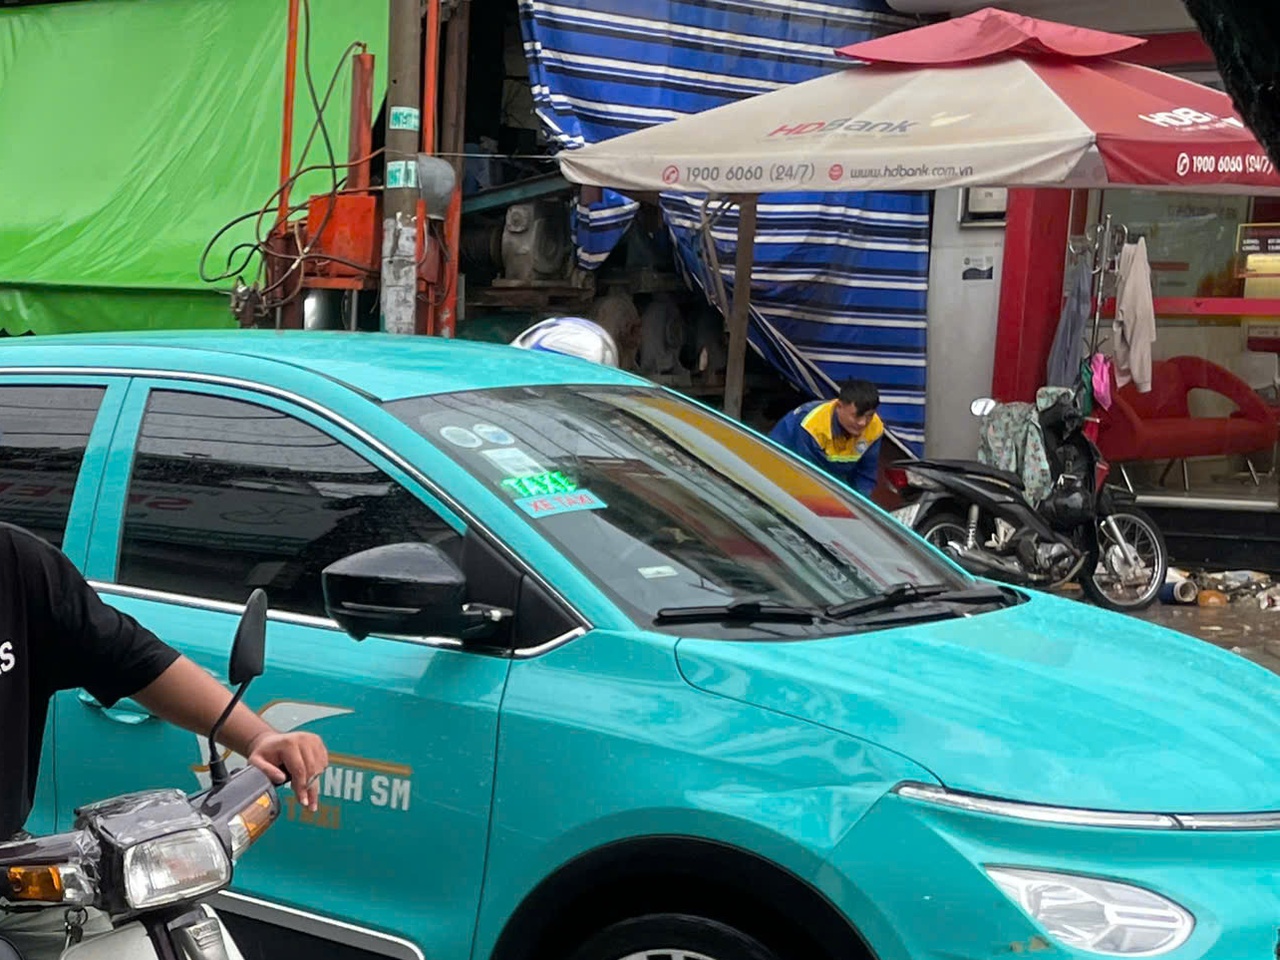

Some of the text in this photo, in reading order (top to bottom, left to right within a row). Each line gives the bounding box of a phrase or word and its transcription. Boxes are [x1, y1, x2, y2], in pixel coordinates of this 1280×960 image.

[768, 117, 919, 136] HDBank
[686, 162, 815, 183] 1900 6060 (24/7)
[850, 164, 974, 180] www.hdbank.com.vn
[1193, 155, 1215, 173] 1900
[1218, 155, 1242, 173] 6060
[370, 774, 412, 811] SM
